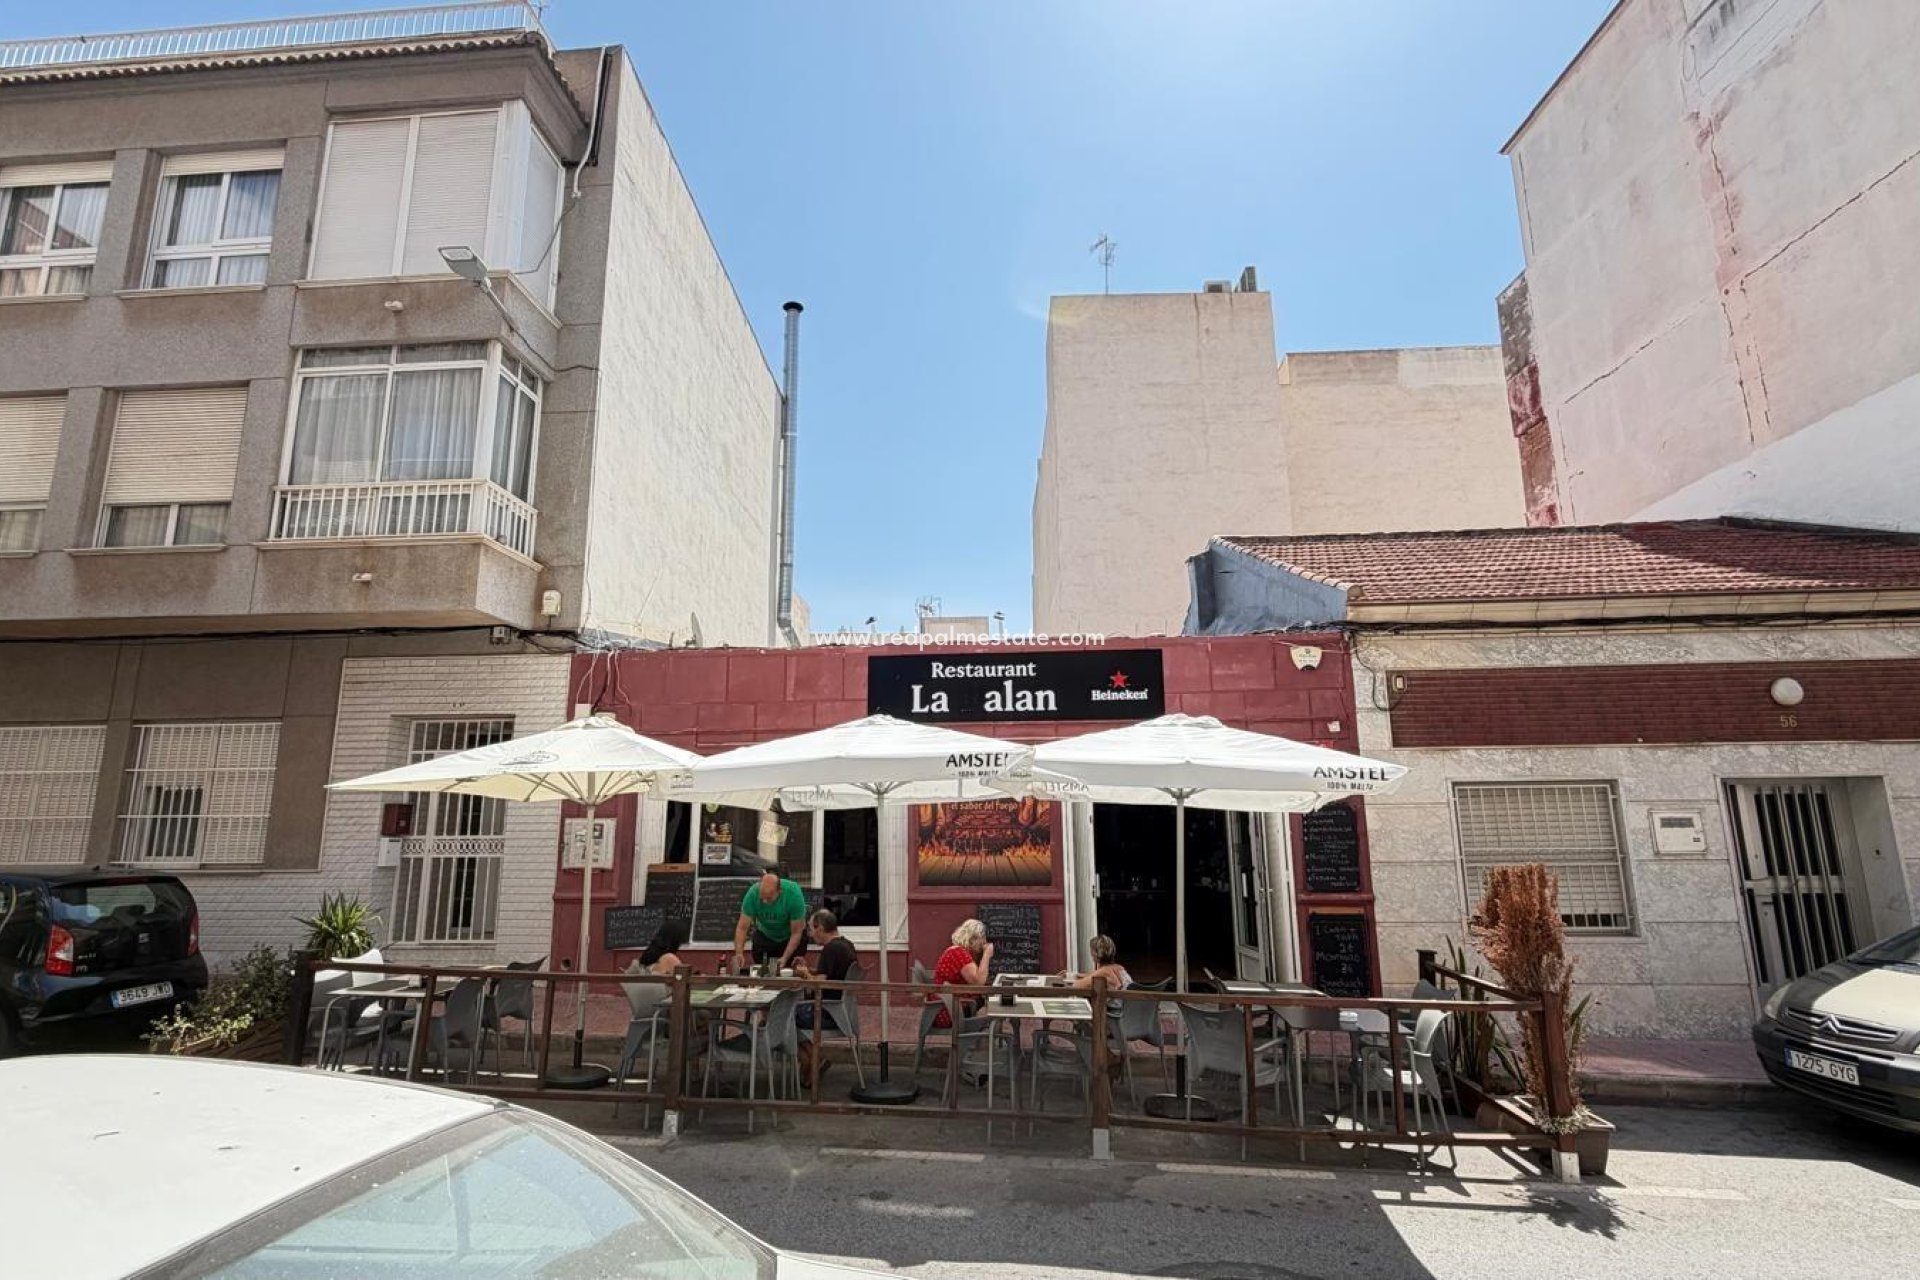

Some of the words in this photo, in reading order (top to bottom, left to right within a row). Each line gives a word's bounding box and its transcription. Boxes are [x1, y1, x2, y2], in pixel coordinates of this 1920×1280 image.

[931, 661, 1036, 678] Restaurant
[911, 684, 949, 713] La
[984, 680, 1057, 712] alan
[1091, 688, 1148, 701] Heineken
[1780, 714, 1798, 728] 56
[1313, 766, 1391, 782] AMSTEL
[1327, 782, 1347, 790] 100%
[1794, 1053, 1824, 1073] 1275
[1829, 1063, 1856, 1081] GYG
